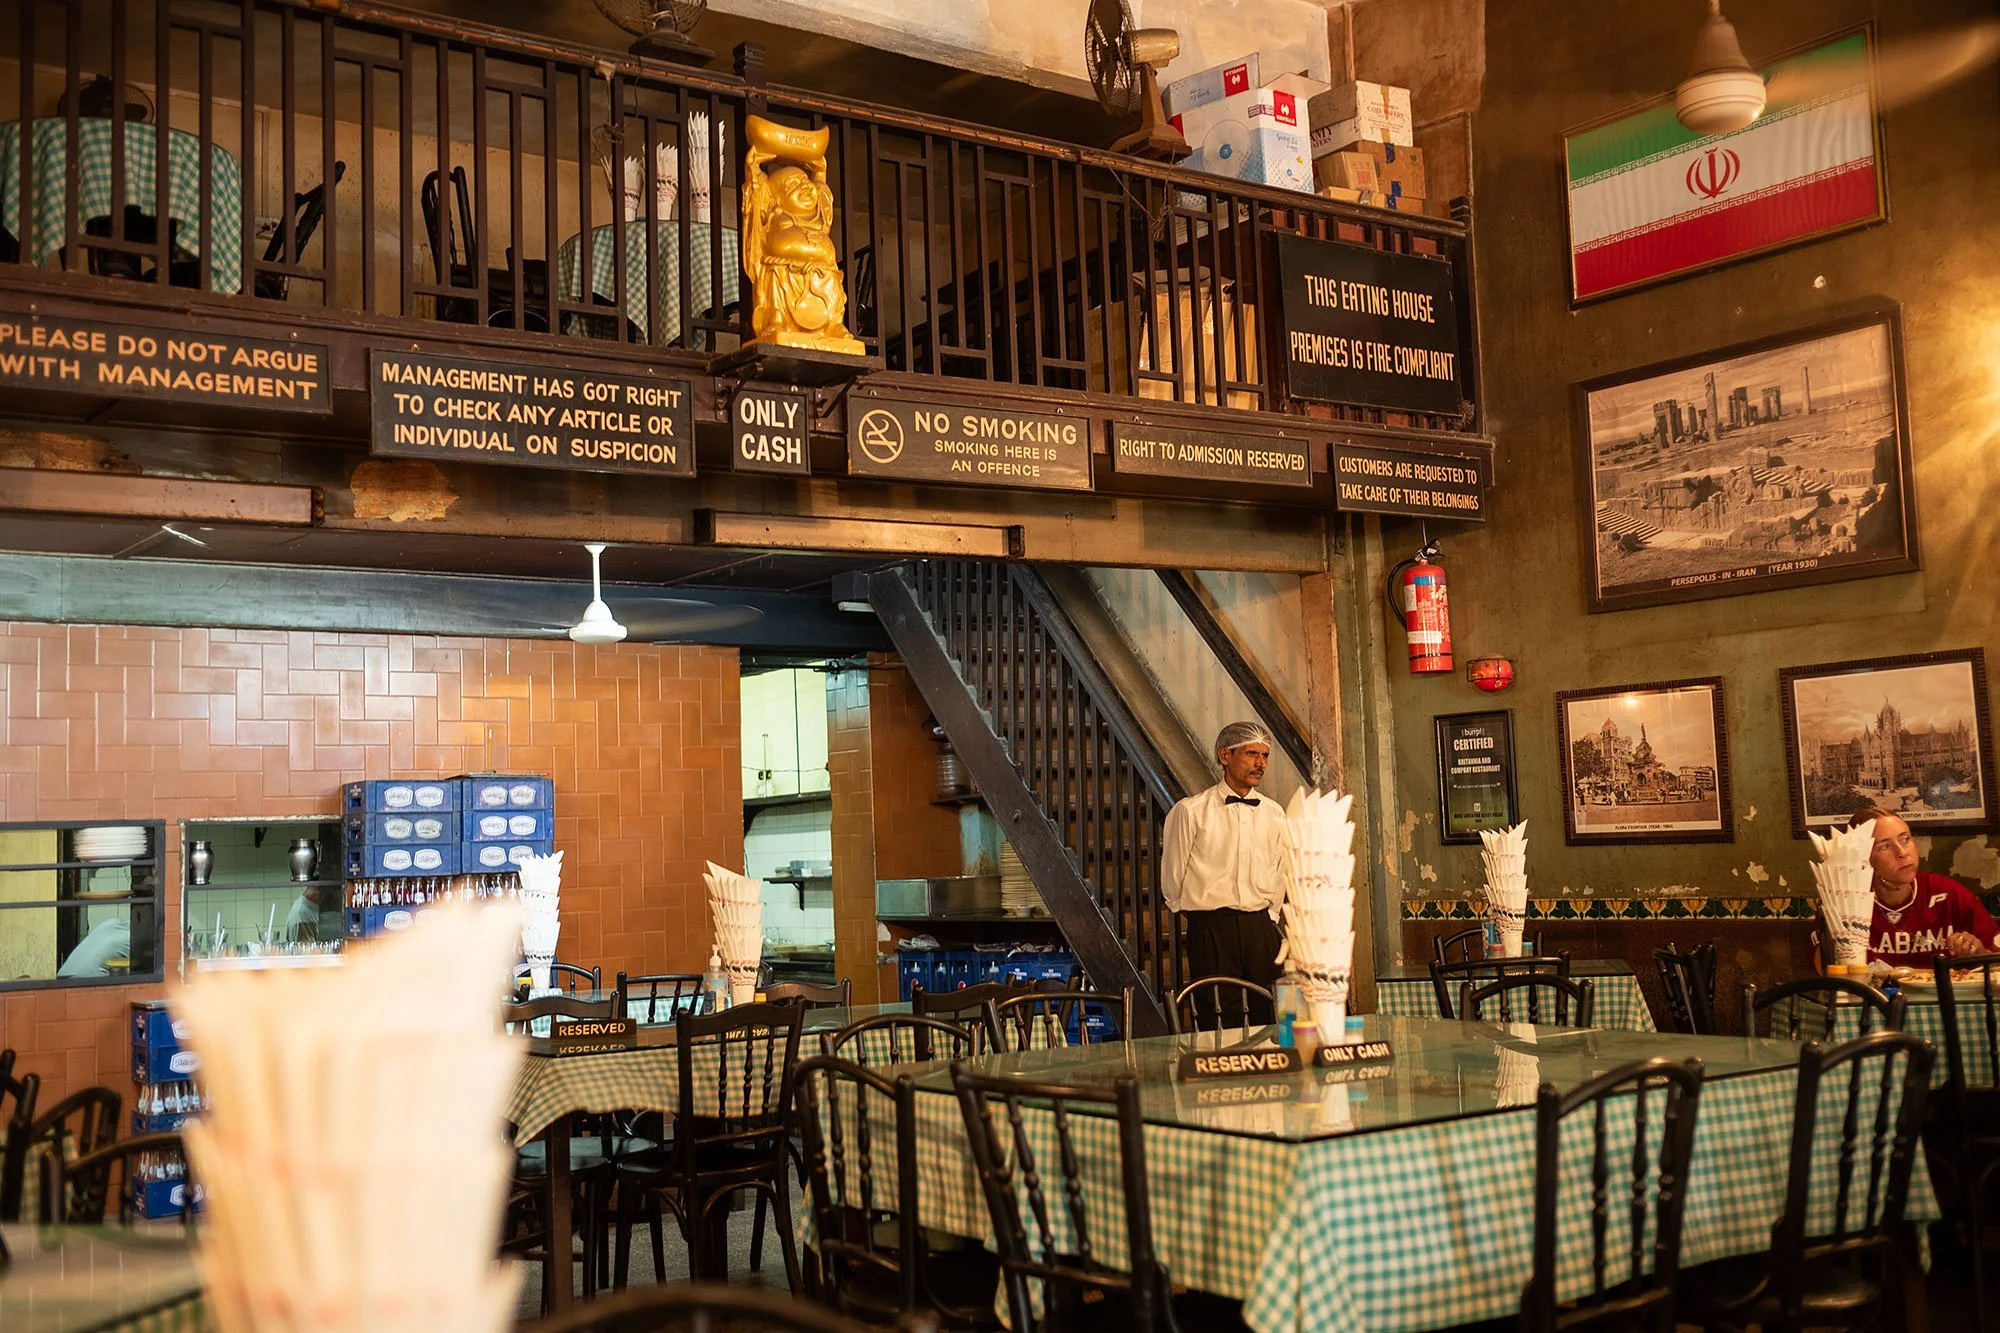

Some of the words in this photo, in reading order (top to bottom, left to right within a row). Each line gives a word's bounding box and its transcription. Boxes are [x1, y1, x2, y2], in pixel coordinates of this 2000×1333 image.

[1275, 114, 1296, 124] HAVELLS
[1304, 274, 1338, 308] THIS
[1341, 280, 1389, 317] EATING
[1392, 289, 1435, 324] HOUSE
[0, 323, 106, 352] PLEASE
[118, 335, 157, 357] DO
[167, 340, 227, 364] NOT
[231, 347, 318, 373] ARGUE
[1290, 331, 1348, 368] PREMISES
[1351, 339, 1364, 370] IS
[1366, 341, 1393, 374] FIRE
[1394, 345, 1454, 382] COMPLIANT
[0, 354, 80, 380] WITH
[99, 362, 318, 400] MANAGEMENT
[382, 362, 527, 394] MANAGEMENT
[533, 377, 574, 399] HAS
[582, 382, 620, 402] GOT
[625, 385, 682, 409] RIGHT
[394, 393, 424, 415] TO
[433, 397, 502, 422] CHECK
[507, 403, 556, 427] ANY
[558, 408, 641, 433] ARTICLE
[647, 415, 675, 436] OR
[740, 397, 799, 429] ONLY
[914, 410, 951, 434] NO
[962, 415, 1077, 446] SMOKING
[394, 424, 515, 452] INDIVIDUAL
[526, 435, 558, 455] ON
[571, 438, 676, 465] SUSPICION
[741, 434, 802, 464] CASH
[934, 439, 999, 457] SMOKING
[1004, 444, 1041, 460] HERE
[1043, 448, 1057, 461] IS
[1119, 438, 1156, 458] RIGHT
[1158, 441, 1175, 460] TO
[1177, 444, 1243, 467] ADMISSION
[1247, 450, 1305, 472] RESERVED
[951, 459, 973, 472] AN
[976, 461, 1041, 478] OFFENCE
[1339, 456, 1393, 476] CUSTOMERS
[1395, 460, 1413, 479] ARE
[1414, 463, 1464, 484] REQUESTED
[1465, 468, 1477, 485] TO
[1340, 483, 1363, 501] TAKE
[1364, 485, 1388, 503] CARE
[1389, 487, 1402, 503] OF
[1402, 488, 1430, 506] THEIR
[1431, 490, 1479, 511] BELONGINGS
[1671, 573, 1717, 587] PERSEPOLIS
[1722, 570, 1731, 580] IN
[1736, 567, 1757, 578] IRAN
[1768, 561, 1793, 574] (YEAR
[1794, 558, 1818, 570] 1930)
[1453, 737, 1494, 751] CERTIFIED
[559, 1022, 626, 1037] RESERVED
[1195, 1053, 1290, 1074] RESERVED
[1323, 1046, 1355, 1062] ONLY
[1357, 1042, 1390, 1058] CASH
